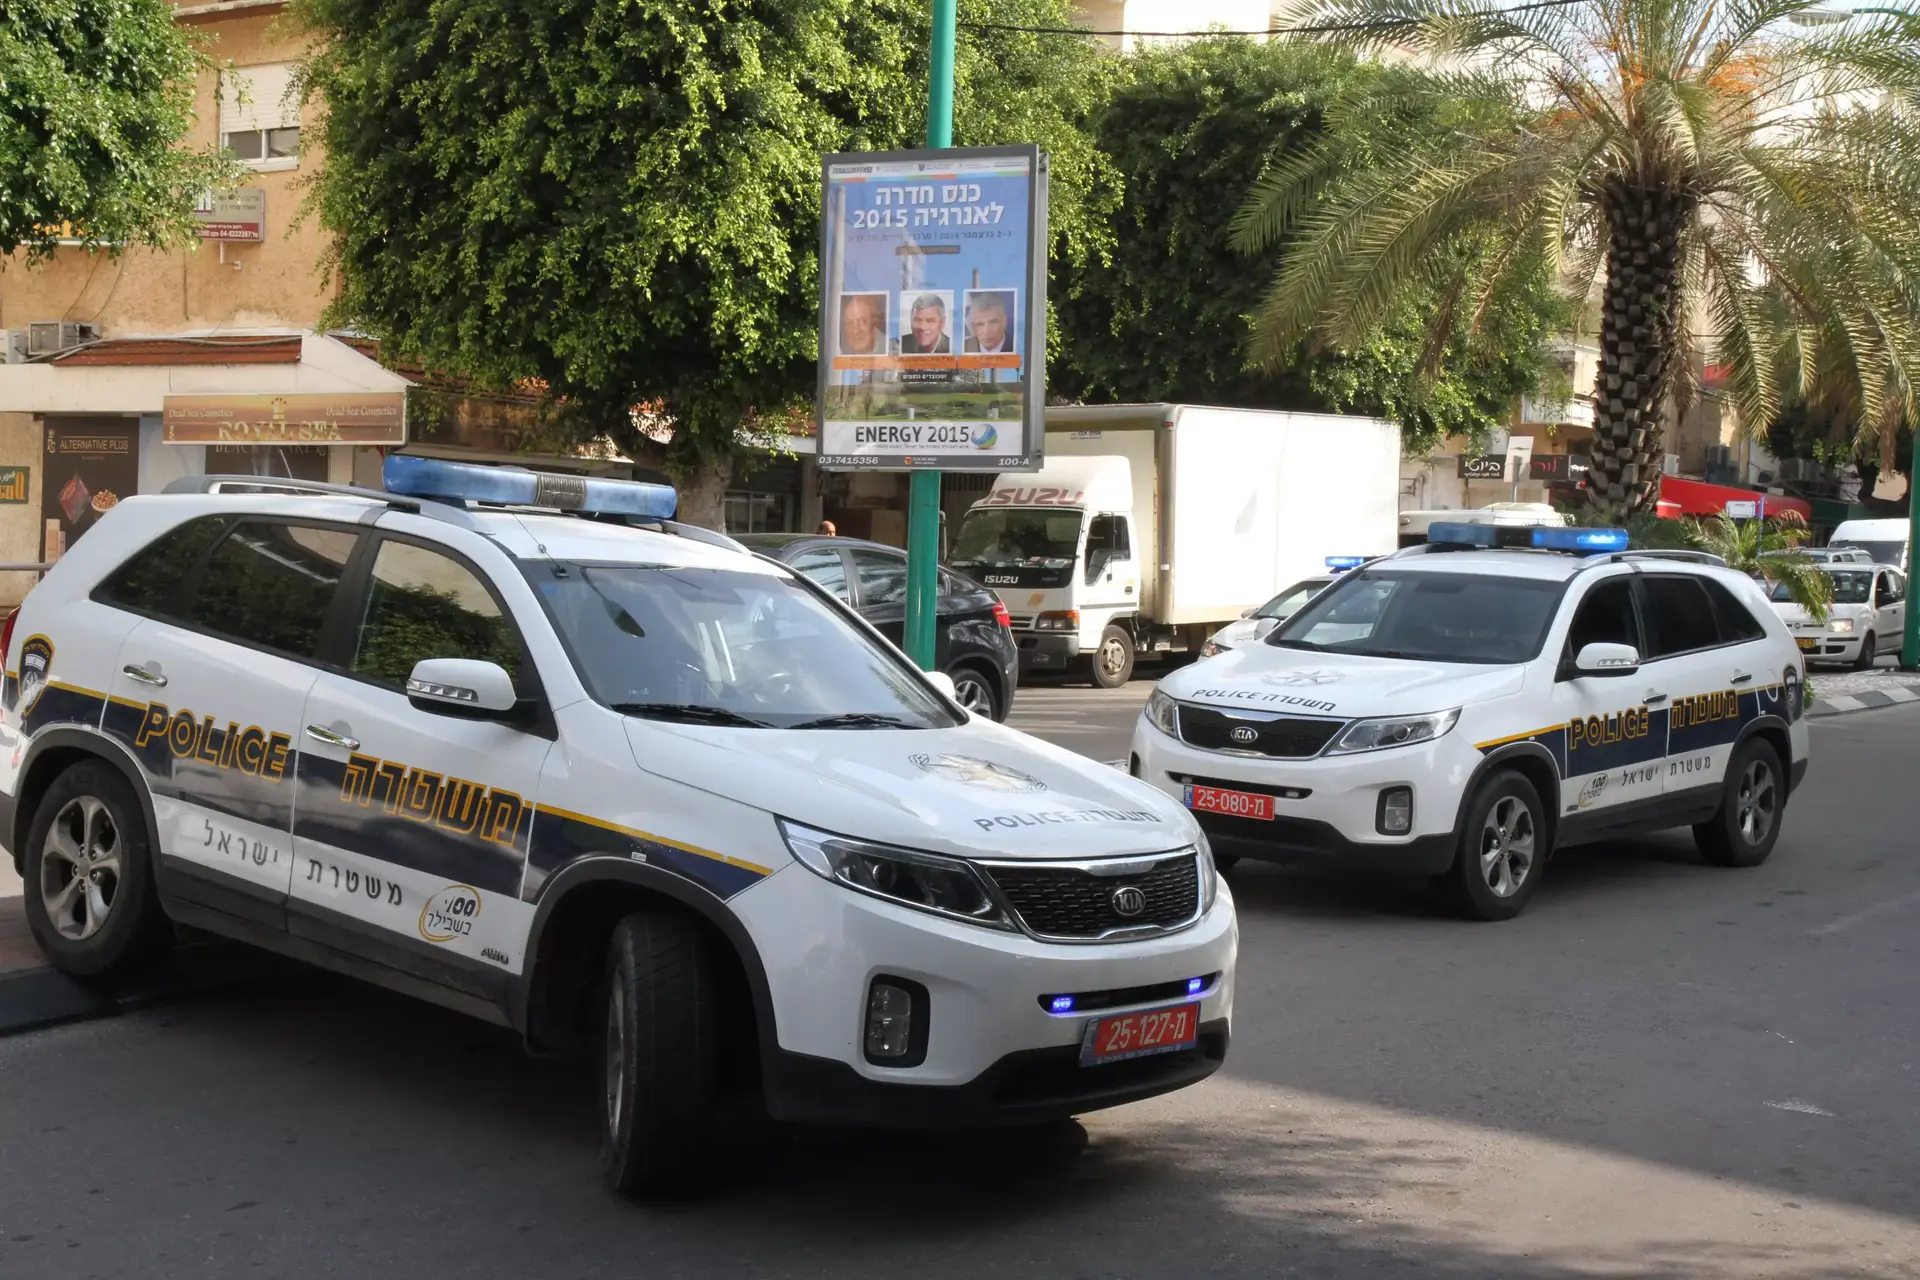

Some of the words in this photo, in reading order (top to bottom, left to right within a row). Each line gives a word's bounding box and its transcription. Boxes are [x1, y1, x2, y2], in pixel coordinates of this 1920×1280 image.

[876, 184, 934, 206] חדרה
[942, 184, 981, 204] כנס
[854, 209, 908, 229] 2015
[914, 201, 1004, 227] לאנרגיה
[169, 409, 186, 418] Dead
[188, 409, 199, 418] Sea
[200, 408, 233, 418] Cosmetics
[326, 407, 344, 416] Dead
[346, 407, 359, 416] Sea
[361, 406, 397, 416] Cosmetics
[218, 421, 290, 440] ROYAL
[299, 421, 343, 440] SEA
[855, 426, 922, 443] ENERGY
[927, 426, 969, 443] 2015
[60, 440, 107, 450] ALTERNATIVE
[109, 440, 129, 450] PLUS
[818, 456, 879, 465] 03-7415356
[998, 457, 1030, 466] 100-A
[982, 488, 1084, 505] ISUZU
[984, 575, 1019, 584] ISUZU
[1192, 689, 1258, 699] POLICE
[1262, 693, 1336, 711] משטרה
[1569, 706, 1649, 749] POLICE
[1671, 689, 1739, 729] משטרה
[1232, 729, 1253, 742] KIA
[135, 701, 292, 782] POLICE
[340, 752, 523, 846] משטרה
[1670, 756, 1711, 776] משטרת
[1622, 767, 1659, 787] ישראל
[973, 811, 1075, 832] POLICE
[1075, 810, 1162, 823] משטרה
[204, 819, 279, 866] ישראל
[307, 858, 403, 906] משטרת
[1118, 891, 1144, 911] KIA
[428, 911, 472, 936] בשבילך
